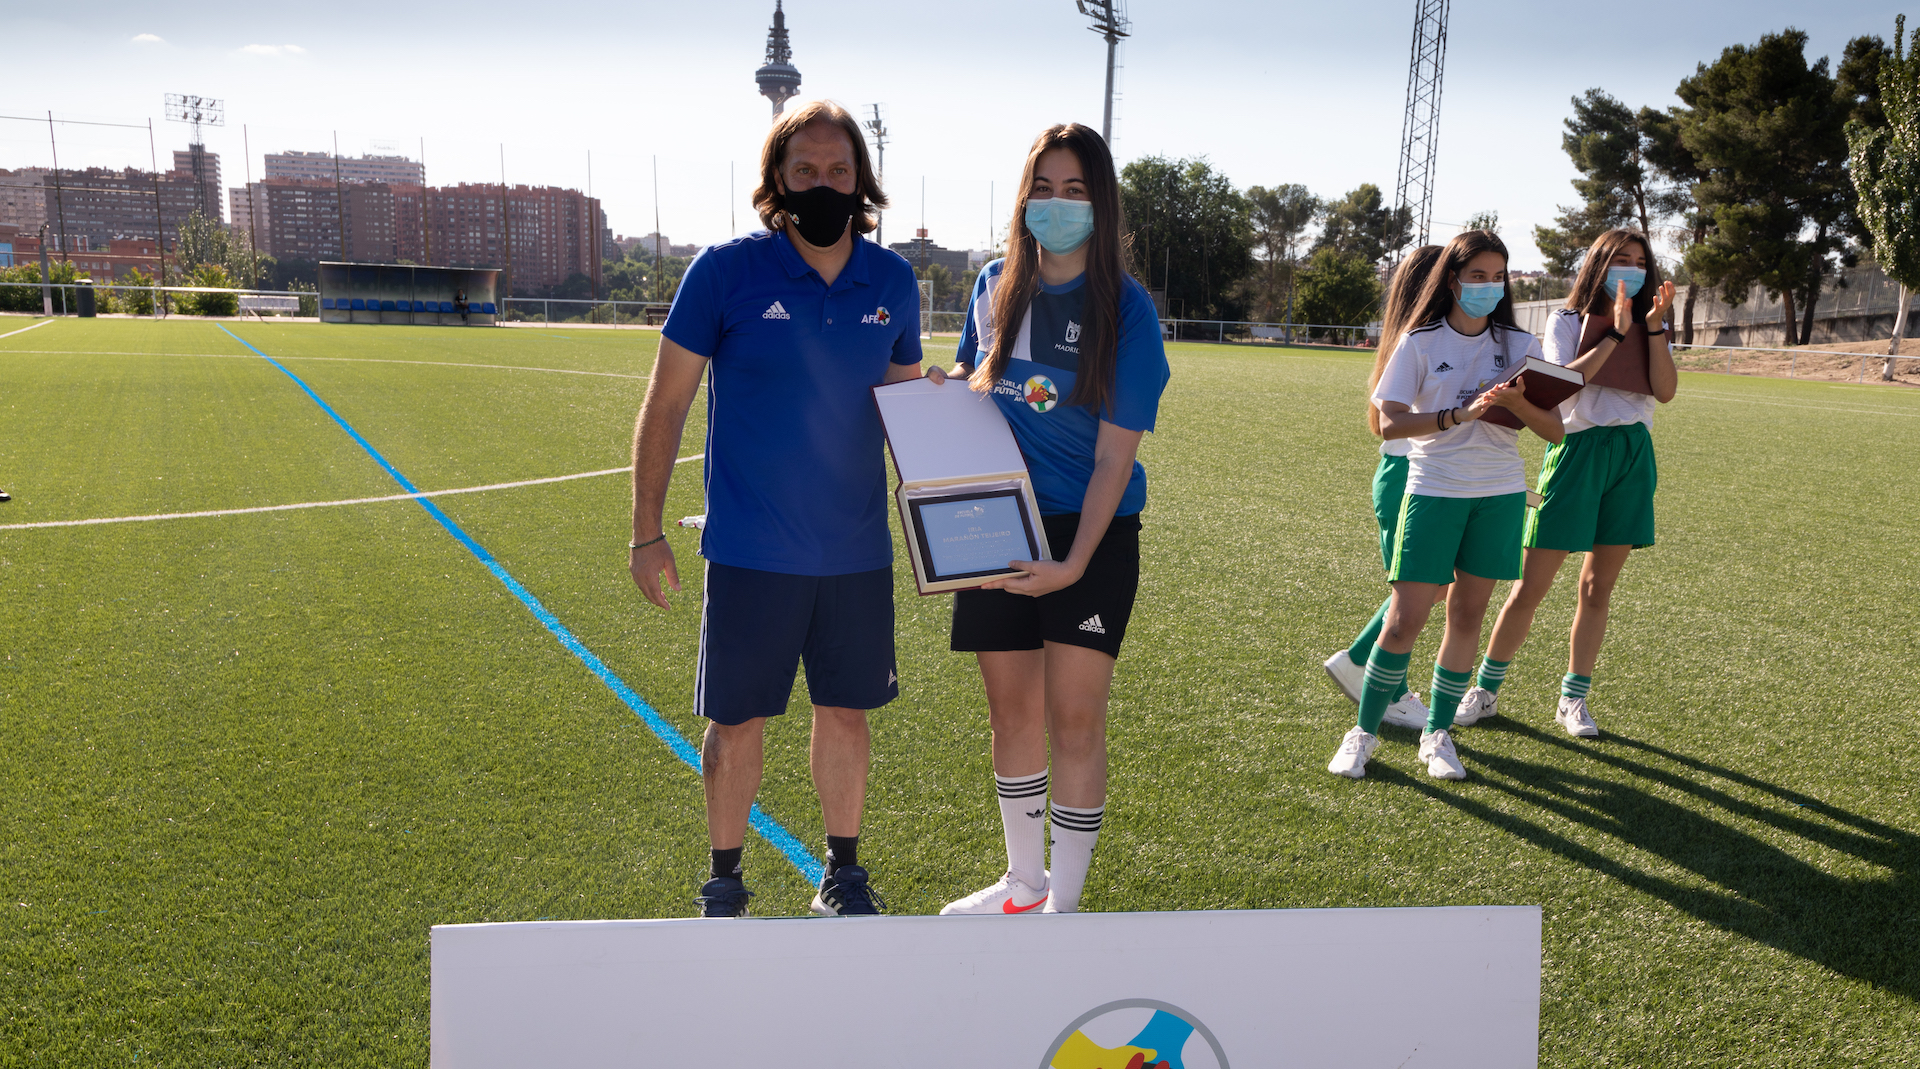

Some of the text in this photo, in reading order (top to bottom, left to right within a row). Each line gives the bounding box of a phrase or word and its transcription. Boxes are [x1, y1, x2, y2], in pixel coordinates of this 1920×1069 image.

[762, 312, 790, 321] adidas
[861, 314, 879, 324] AFE
[997, 378, 1022, 391] CUELA
[1078, 624, 1106, 635] adidas
